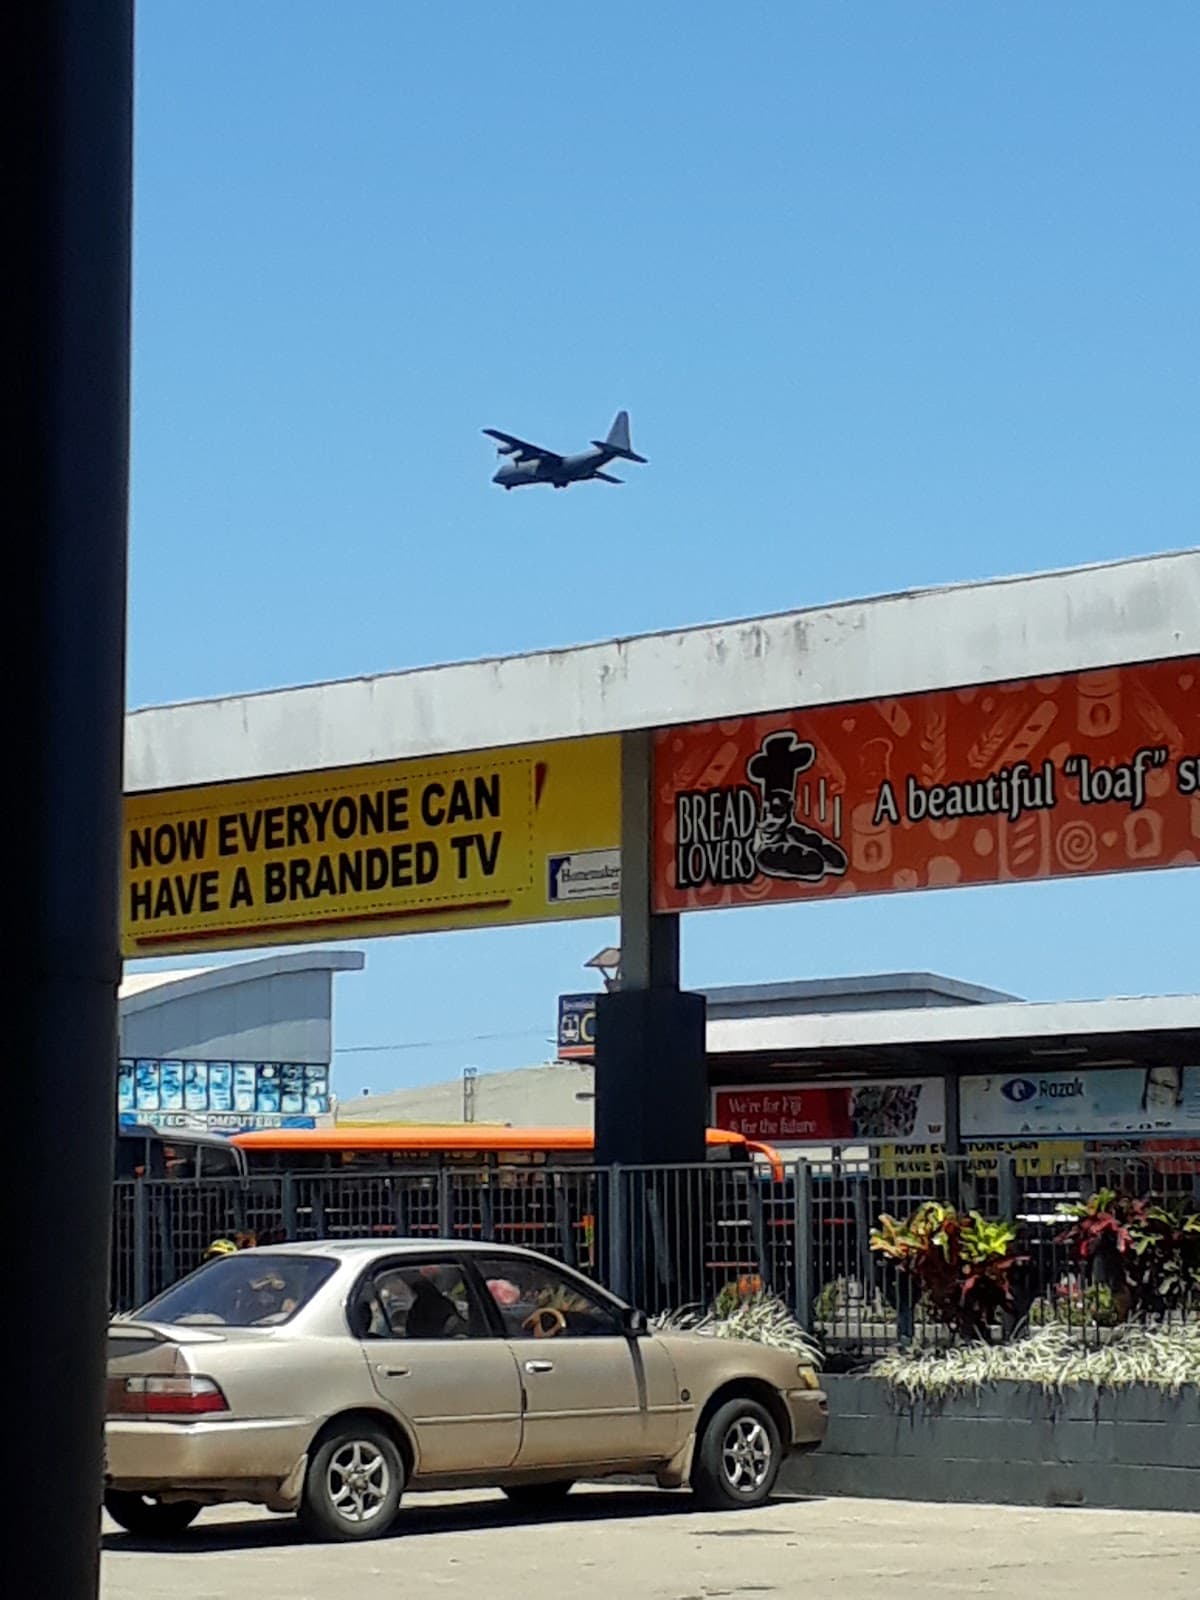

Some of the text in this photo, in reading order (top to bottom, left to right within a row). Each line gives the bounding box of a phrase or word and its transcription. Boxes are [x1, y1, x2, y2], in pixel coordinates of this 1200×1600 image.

[130, 774, 500, 869] NOW EVERYONE CAN
[678, 789, 756, 844] BREAD
[874, 783, 898, 823] A
[909, 762, 1054, 819] beautiful
[130, 831, 502, 921] HAVE A BRANDED TV
[678, 838, 756, 884] LOVERS
